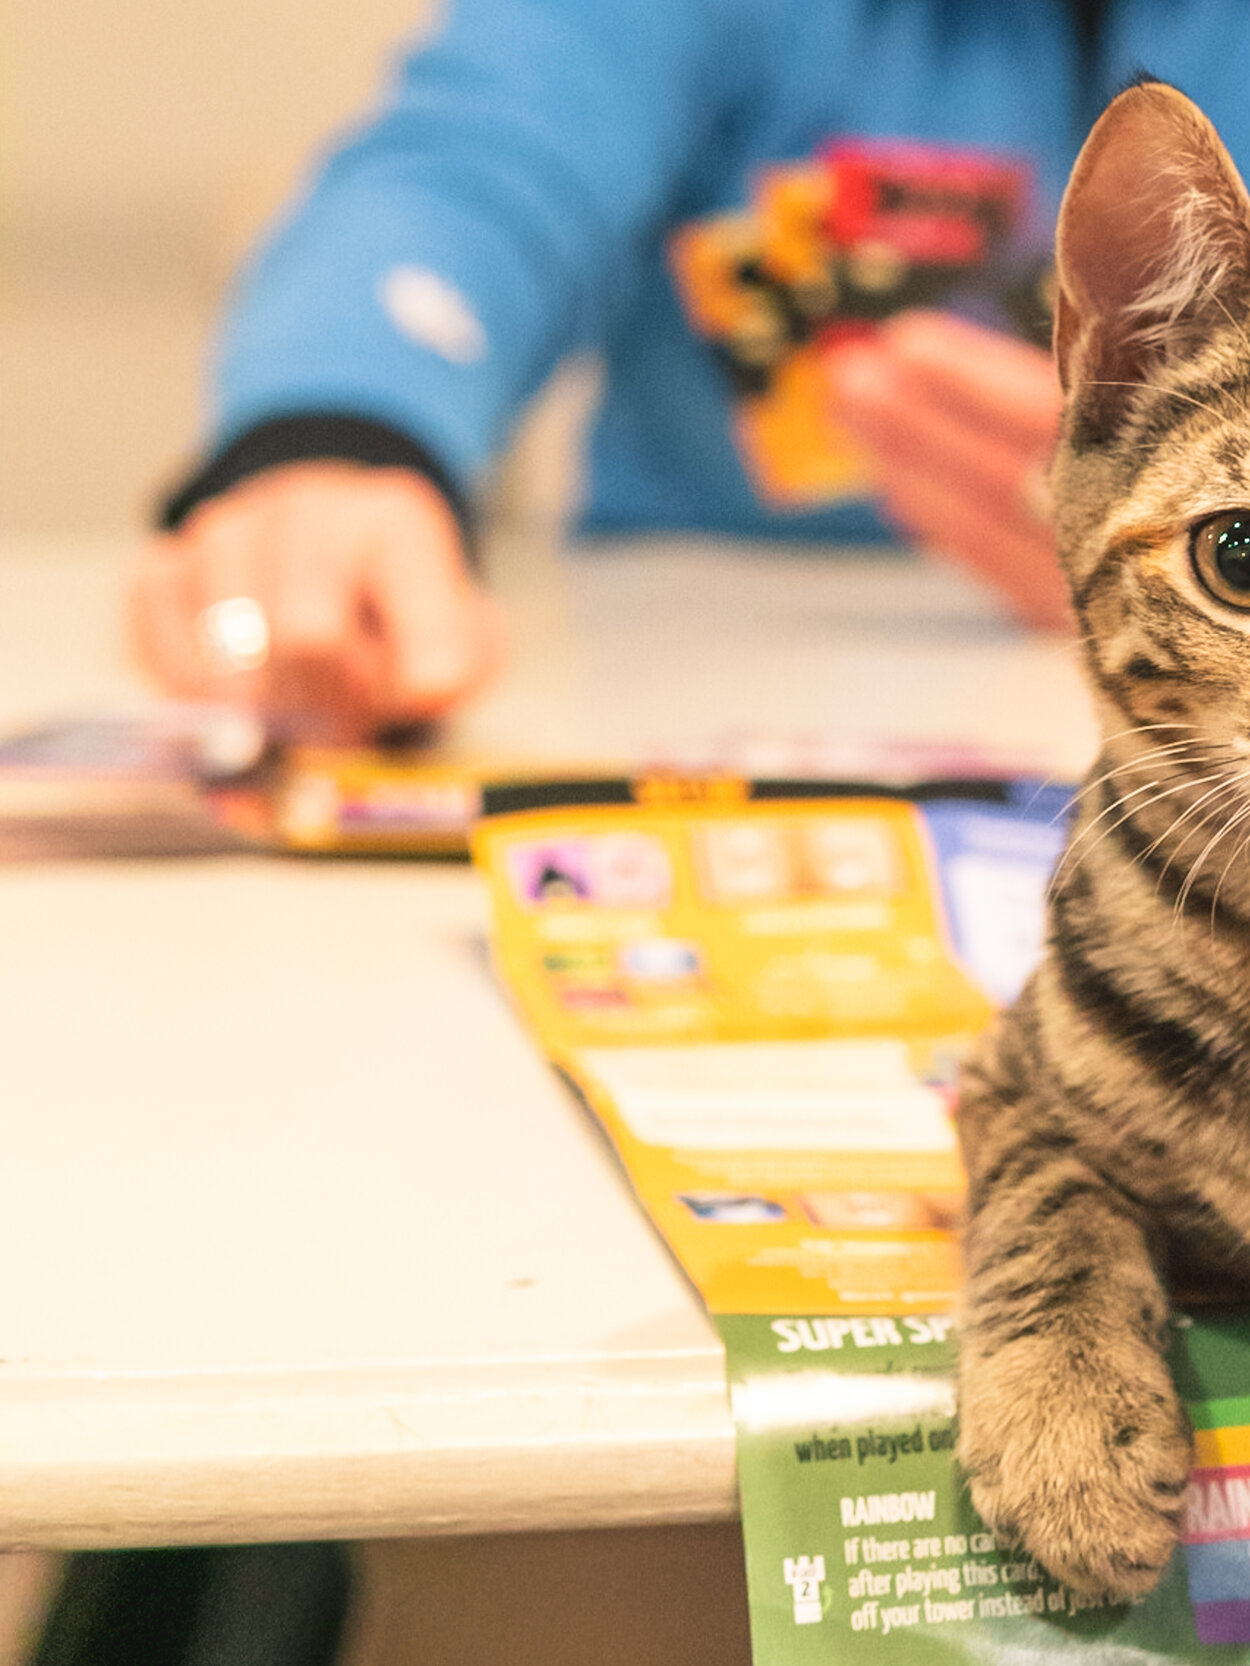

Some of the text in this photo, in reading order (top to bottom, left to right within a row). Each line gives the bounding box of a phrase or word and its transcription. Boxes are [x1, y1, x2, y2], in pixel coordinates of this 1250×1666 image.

[770, 1315, 954, 1353] SUPER SP
[793, 1433, 852, 1463] when
[856, 1423, 925, 1466] played
[839, 1490, 937, 1528] RAINBOW
[843, 1536, 861, 1566] If
[861, 1535, 911, 1565] there
[911, 1536, 942, 1559] are
[943, 1534, 968, 1556] no
[847, 1568, 892, 1598] after
[895, 1564, 962, 1600] playing
[962, 1559, 999, 1587] this
[850, 1601, 880, 1632] off
[879, 1603, 922, 1636] your
[923, 1597, 976, 1624] tower
[978, 1586, 1046, 1618] instead
[1047, 1583, 1066, 1613] of
